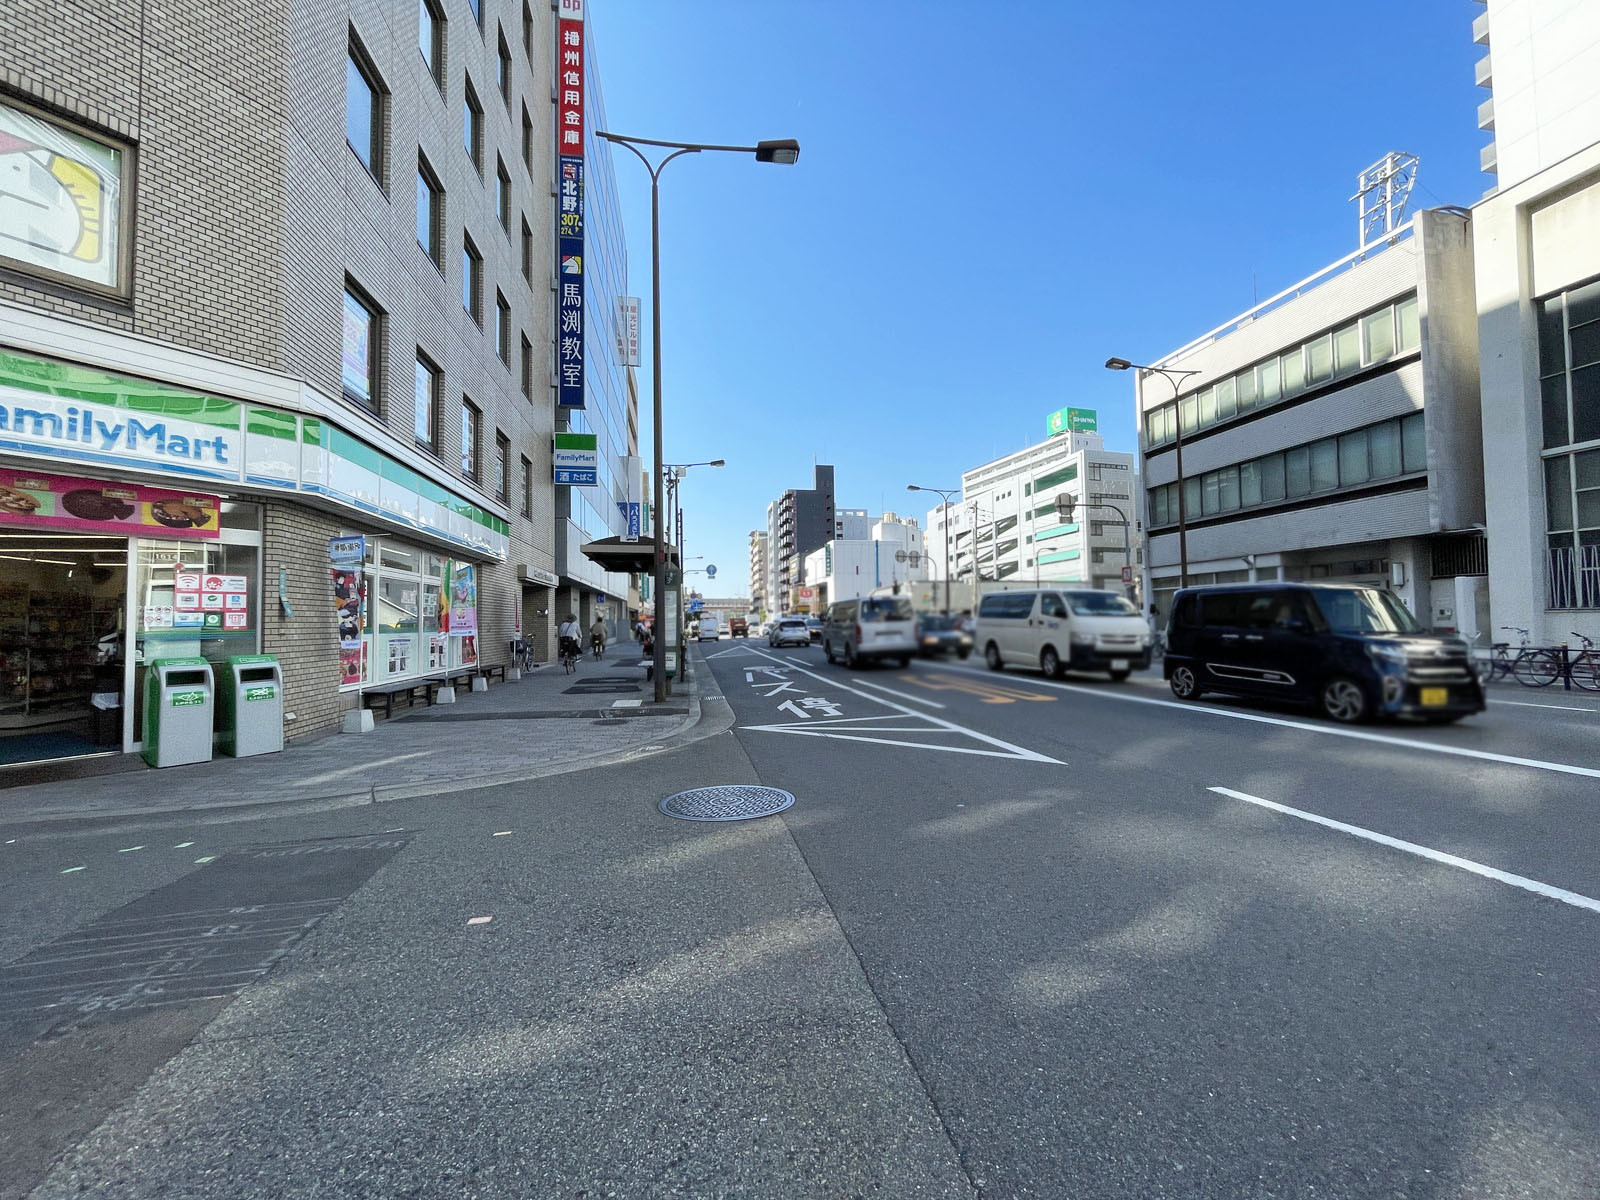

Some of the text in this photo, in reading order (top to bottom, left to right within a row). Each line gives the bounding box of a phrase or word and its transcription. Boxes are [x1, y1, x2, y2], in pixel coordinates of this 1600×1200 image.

[563, 31, 580, 145] 播州信用金庫
[562, 180, 577, 212] 北野
[556, 453, 595, 462] FamilyMart
[559, 471, 593, 482] 酒 たばこ
